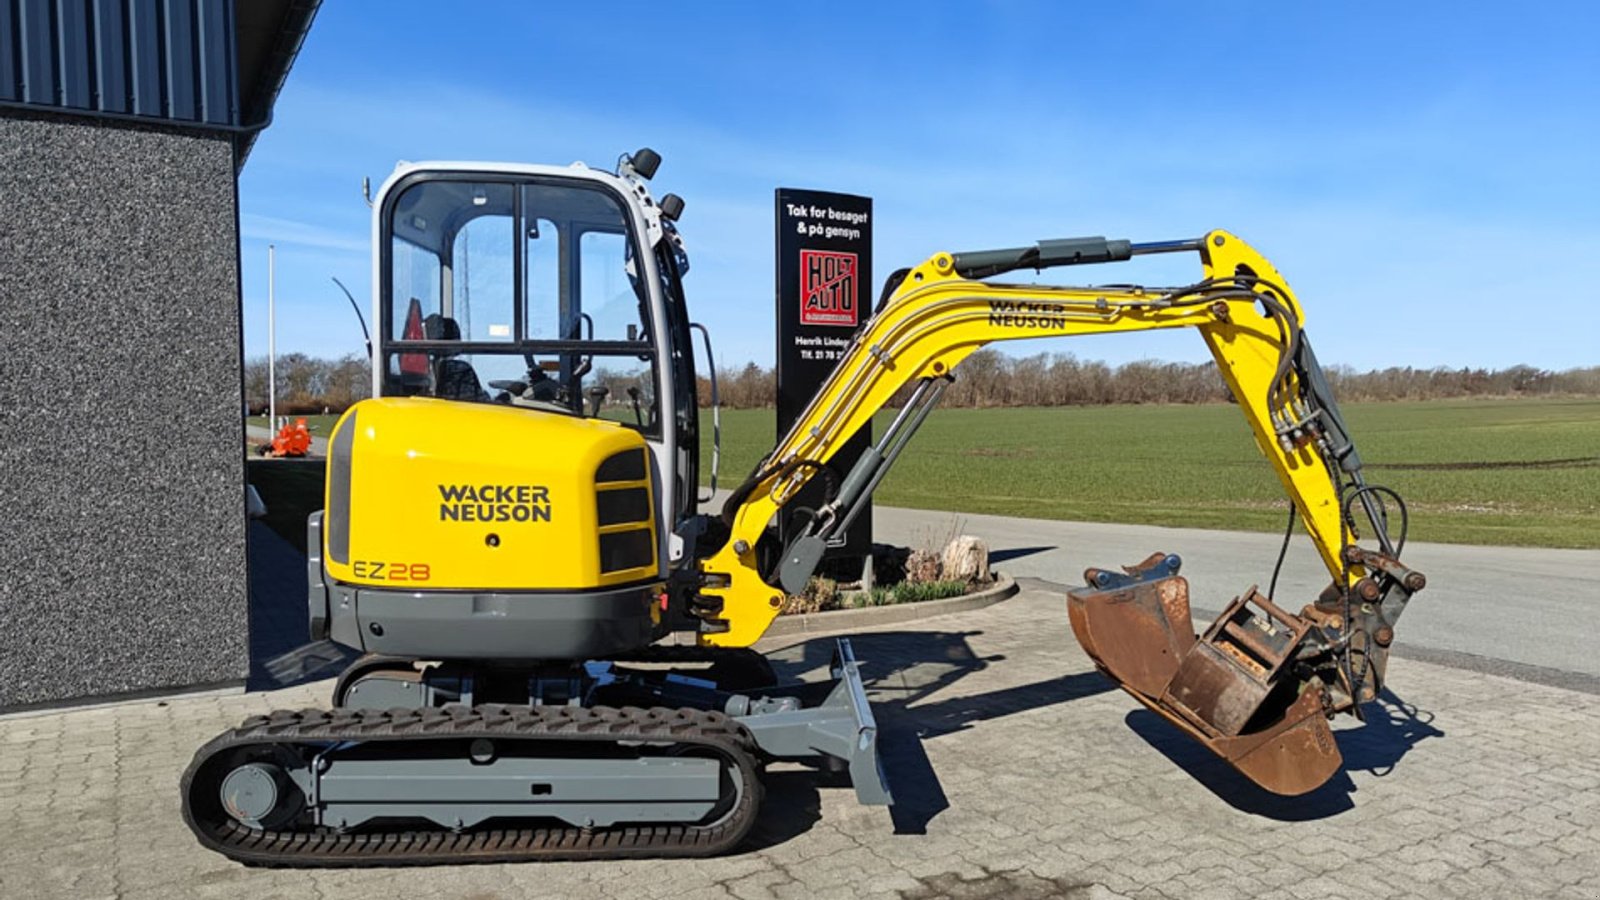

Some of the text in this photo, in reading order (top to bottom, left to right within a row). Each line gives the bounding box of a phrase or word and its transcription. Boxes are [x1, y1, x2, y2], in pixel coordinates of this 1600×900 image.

[787, 204, 867, 224] Tak for besøget
[797, 221, 861, 240] & på gensyn
[808, 254, 852, 292] HOLT
[806, 274, 852, 311] AUTO
[989, 314, 1066, 330] NEUSON
[795, 336, 823, 345] Henrik
[438, 485, 550, 503] WACKER
[440, 505, 552, 522] NEUSON
[353, 560, 431, 581] EZ28
